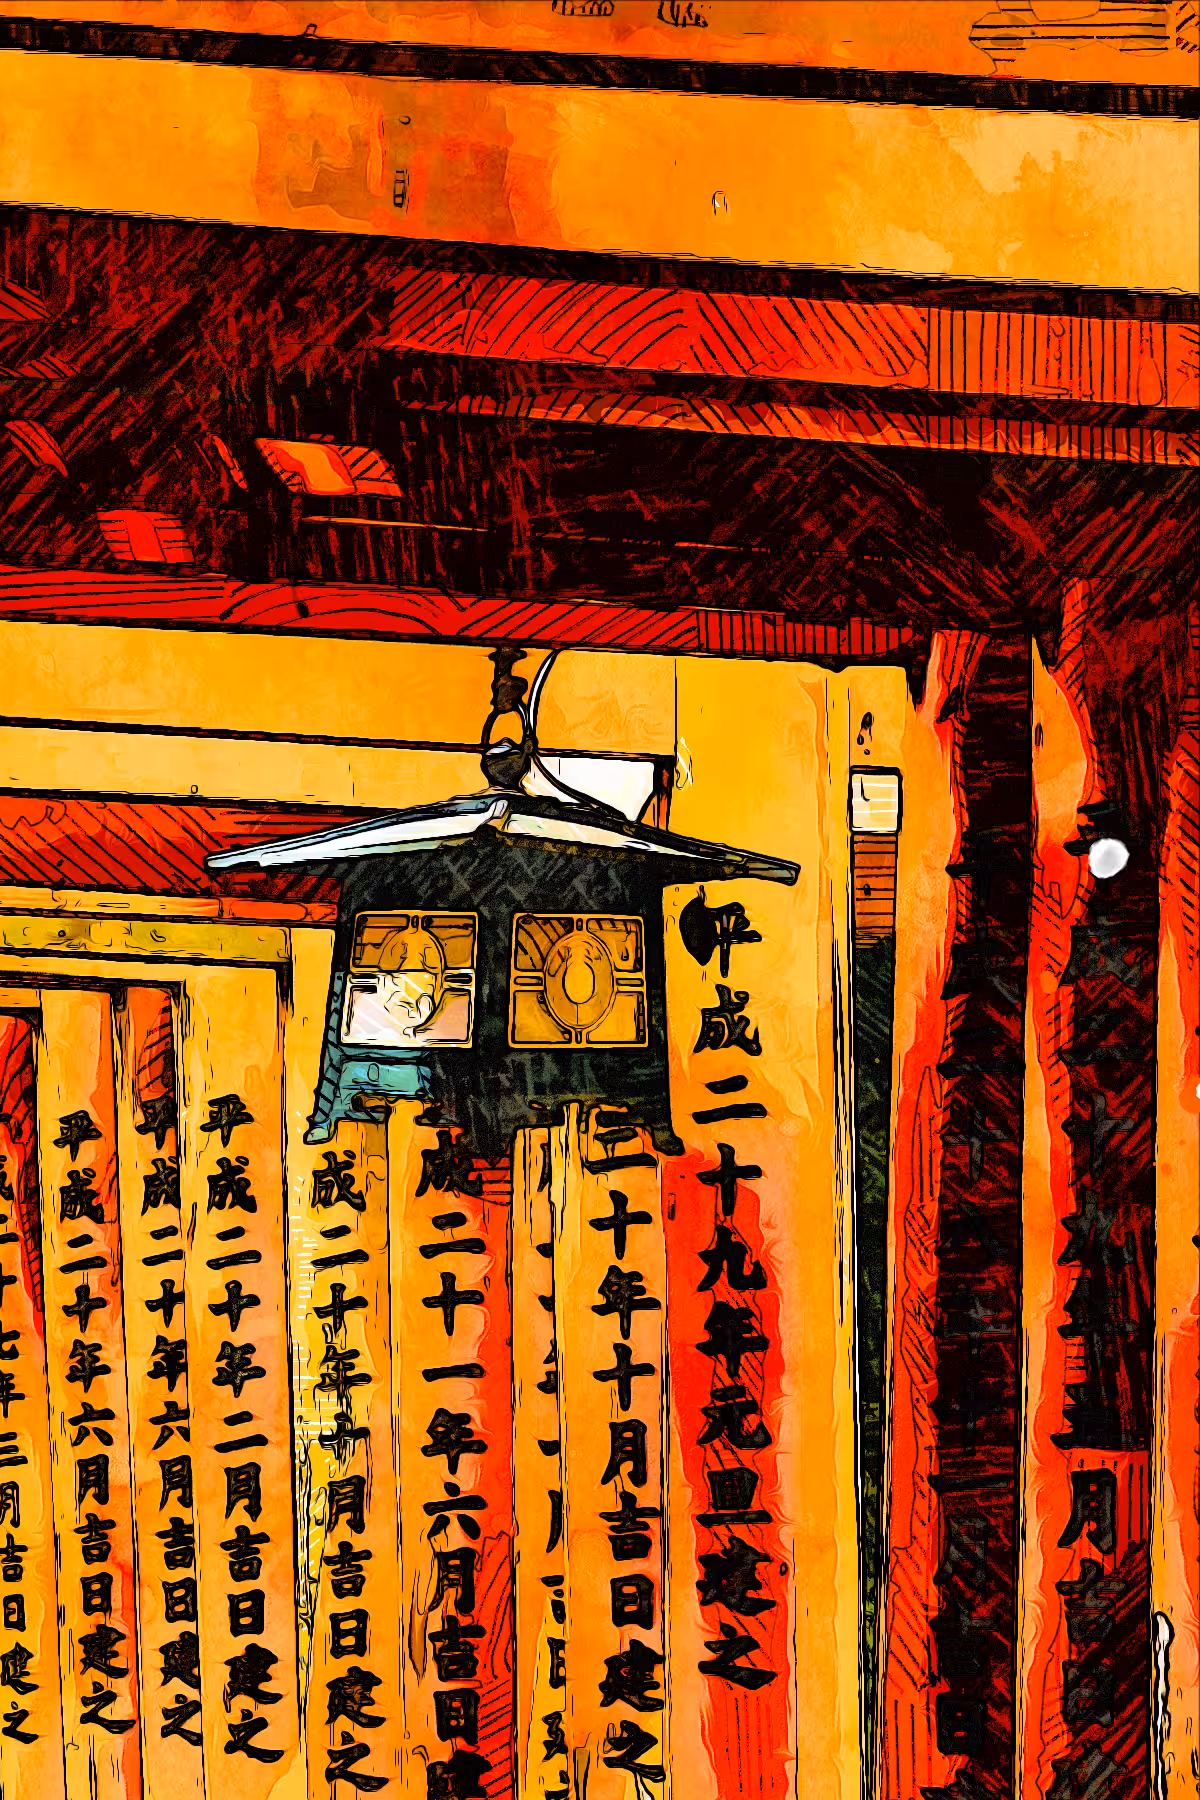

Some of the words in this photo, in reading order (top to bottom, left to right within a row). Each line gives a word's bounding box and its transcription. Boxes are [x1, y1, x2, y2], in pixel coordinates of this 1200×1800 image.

[53, 1109, 136, 1734] 平成二十年六月吉日建之
[135, 1097, 203, 1747] 平成二十年六月吉日建之
[200, 1093, 285, 1764] 平成二十年二月吉日建之
[689, 901, 777, 1690] 平成二十九年元旦建之
